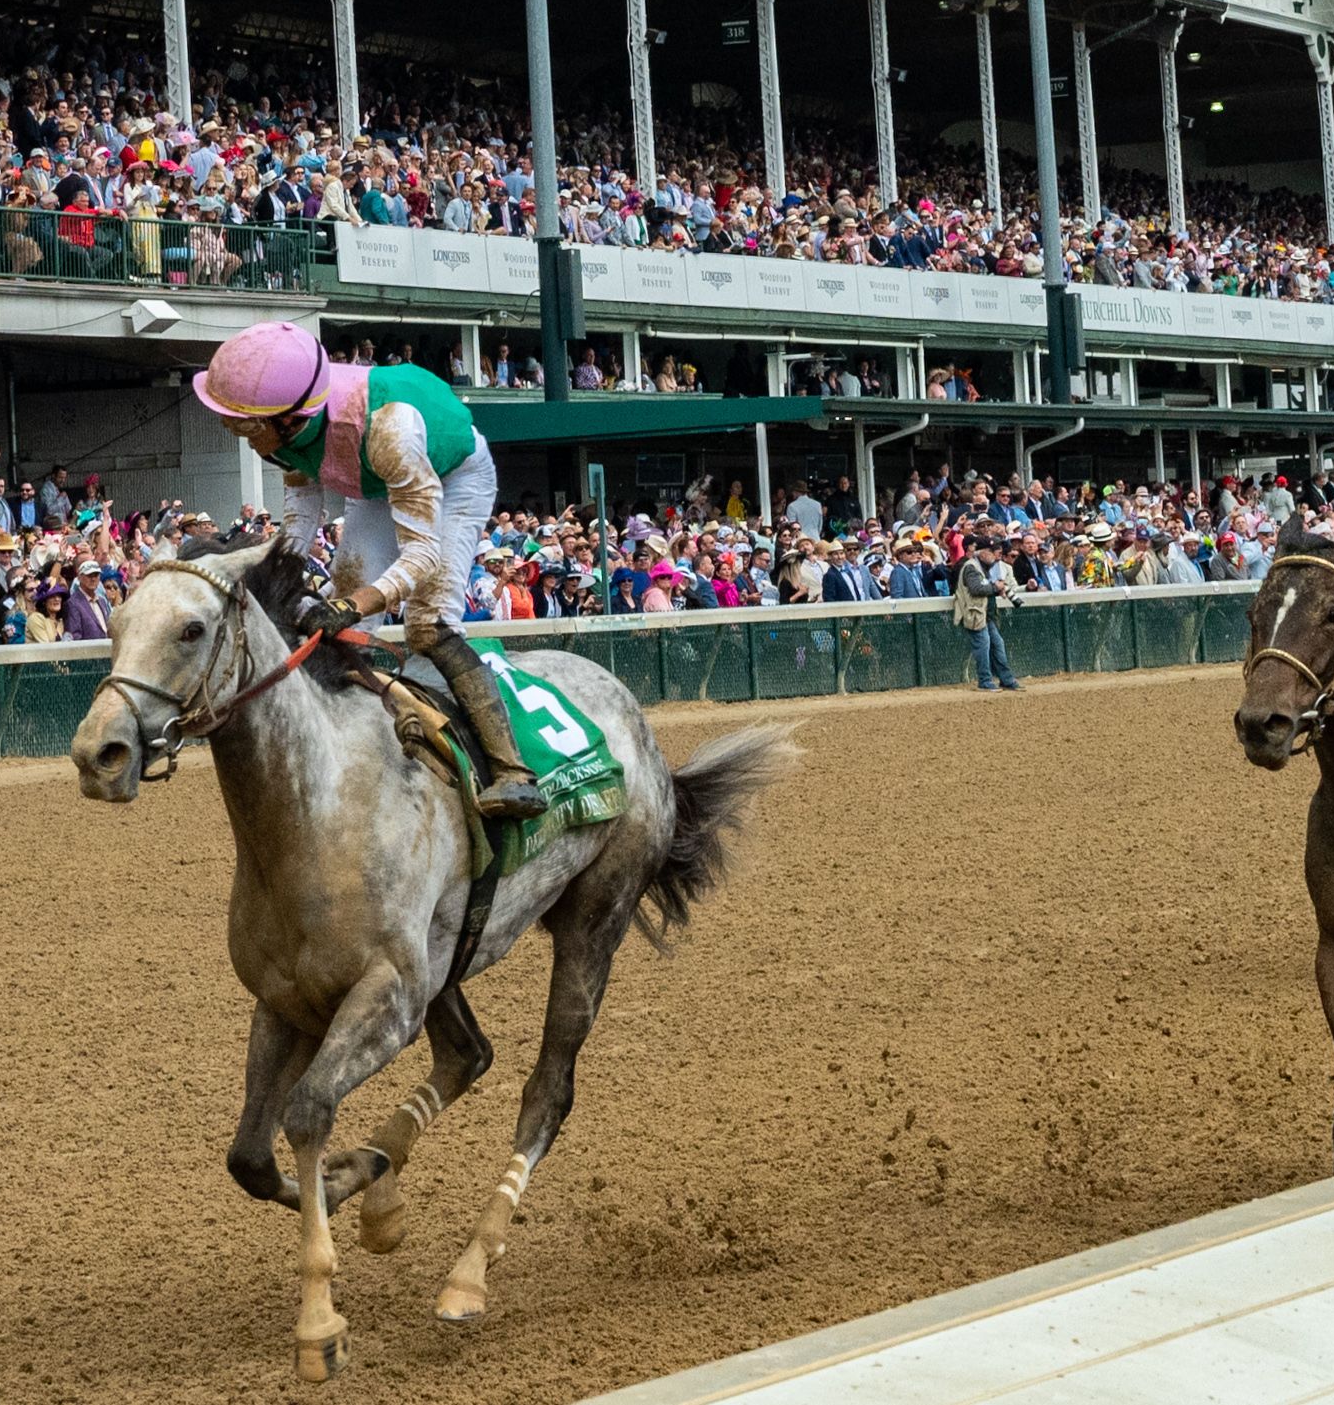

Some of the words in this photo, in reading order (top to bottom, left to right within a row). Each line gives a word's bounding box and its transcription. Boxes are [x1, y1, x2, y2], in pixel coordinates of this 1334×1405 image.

[727, 27, 745, 37] 318
[356, 240, 399, 254] WOODFORD
[362, 256, 397, 269] RESERVE
[432, 249, 471, 264] LONGINES
[504, 252, 537, 264] WOODFOR
[508, 267, 539, 279] RESERV
[582, 262, 608, 275] NGINES
[638, 263, 673, 276] WOODFORD
[642, 278, 672, 289] RESERVE
[701, 270, 732, 284] LONGINES
[759, 272, 792, 284] WOODFORD
[763, 285, 790, 297] RESERVE
[816, 278, 846, 291] LONGINES
[869, 280, 900, 292] WOODFORD
[922, 286, 950, 299] LONGINES
[1019, 294, 1044, 306] LONGINES
[1082, 299, 1131, 323] URCHILL
[1133, 296, 1173, 326] DOWNS
[479, 651, 590, 758] 5
